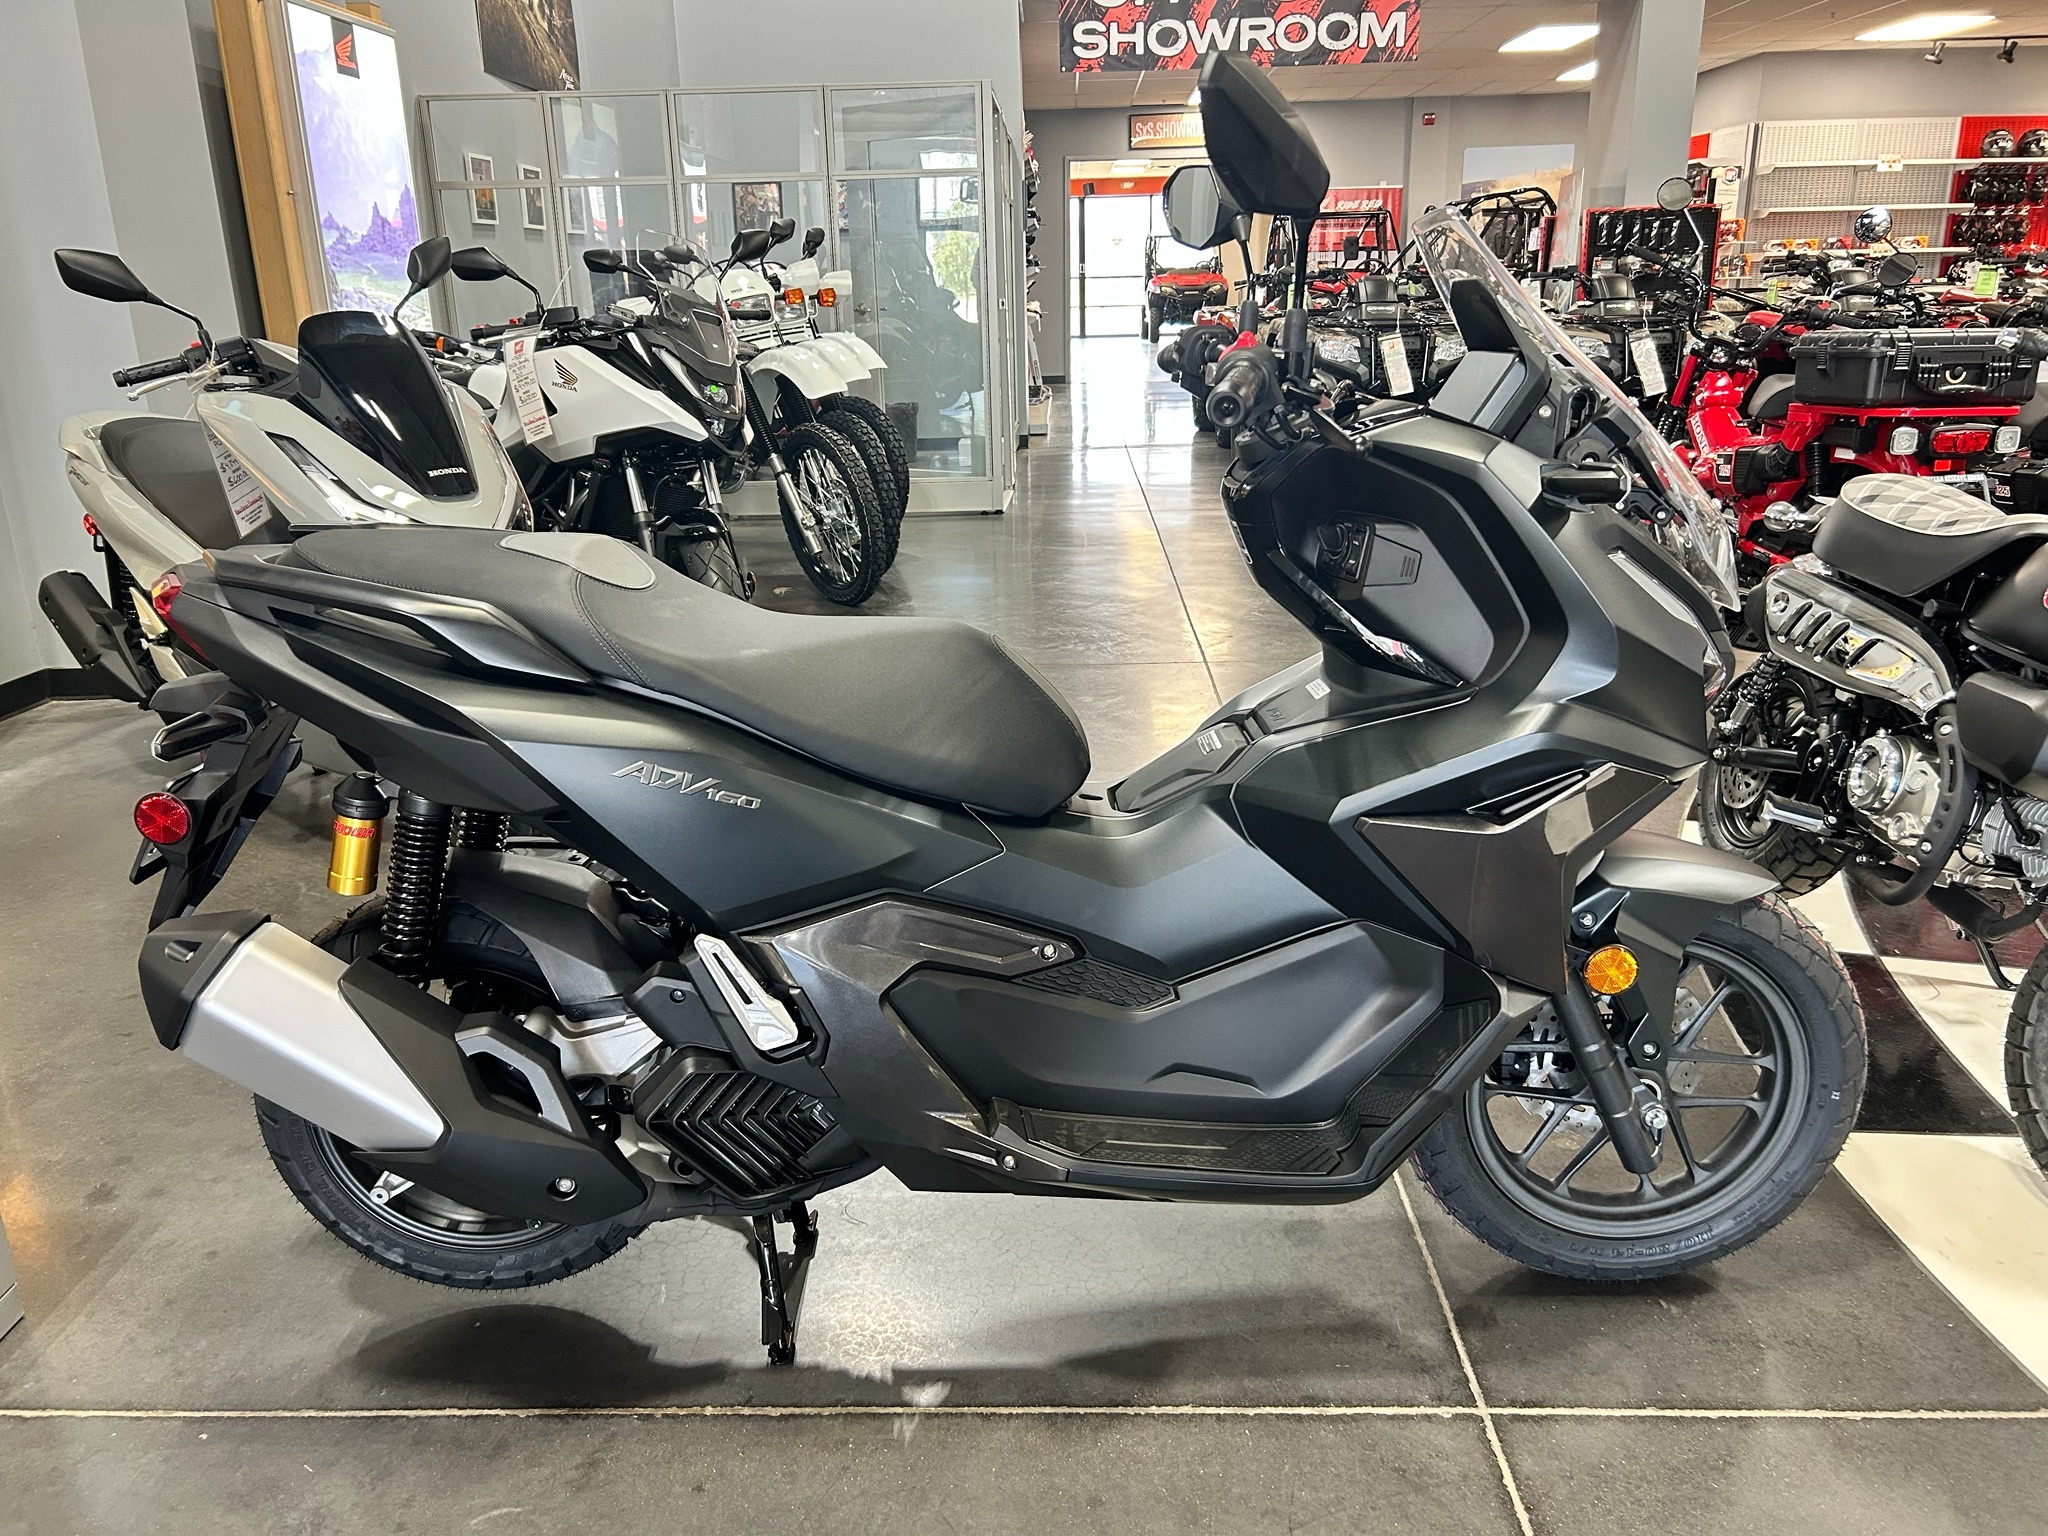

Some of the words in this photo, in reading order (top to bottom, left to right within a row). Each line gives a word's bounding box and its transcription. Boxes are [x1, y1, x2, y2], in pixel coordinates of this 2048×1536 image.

[1073, 11, 1406, 58] SHOWROOM
[1135, 121, 1154, 138] SxS
[1336, 199, 1360, 211] RIDE
[551, 380, 578, 393] HONDA
[427, 467, 467, 478] HONDA
[611, 760, 722, 795] ADV
[706, 787, 761, 809] 160
